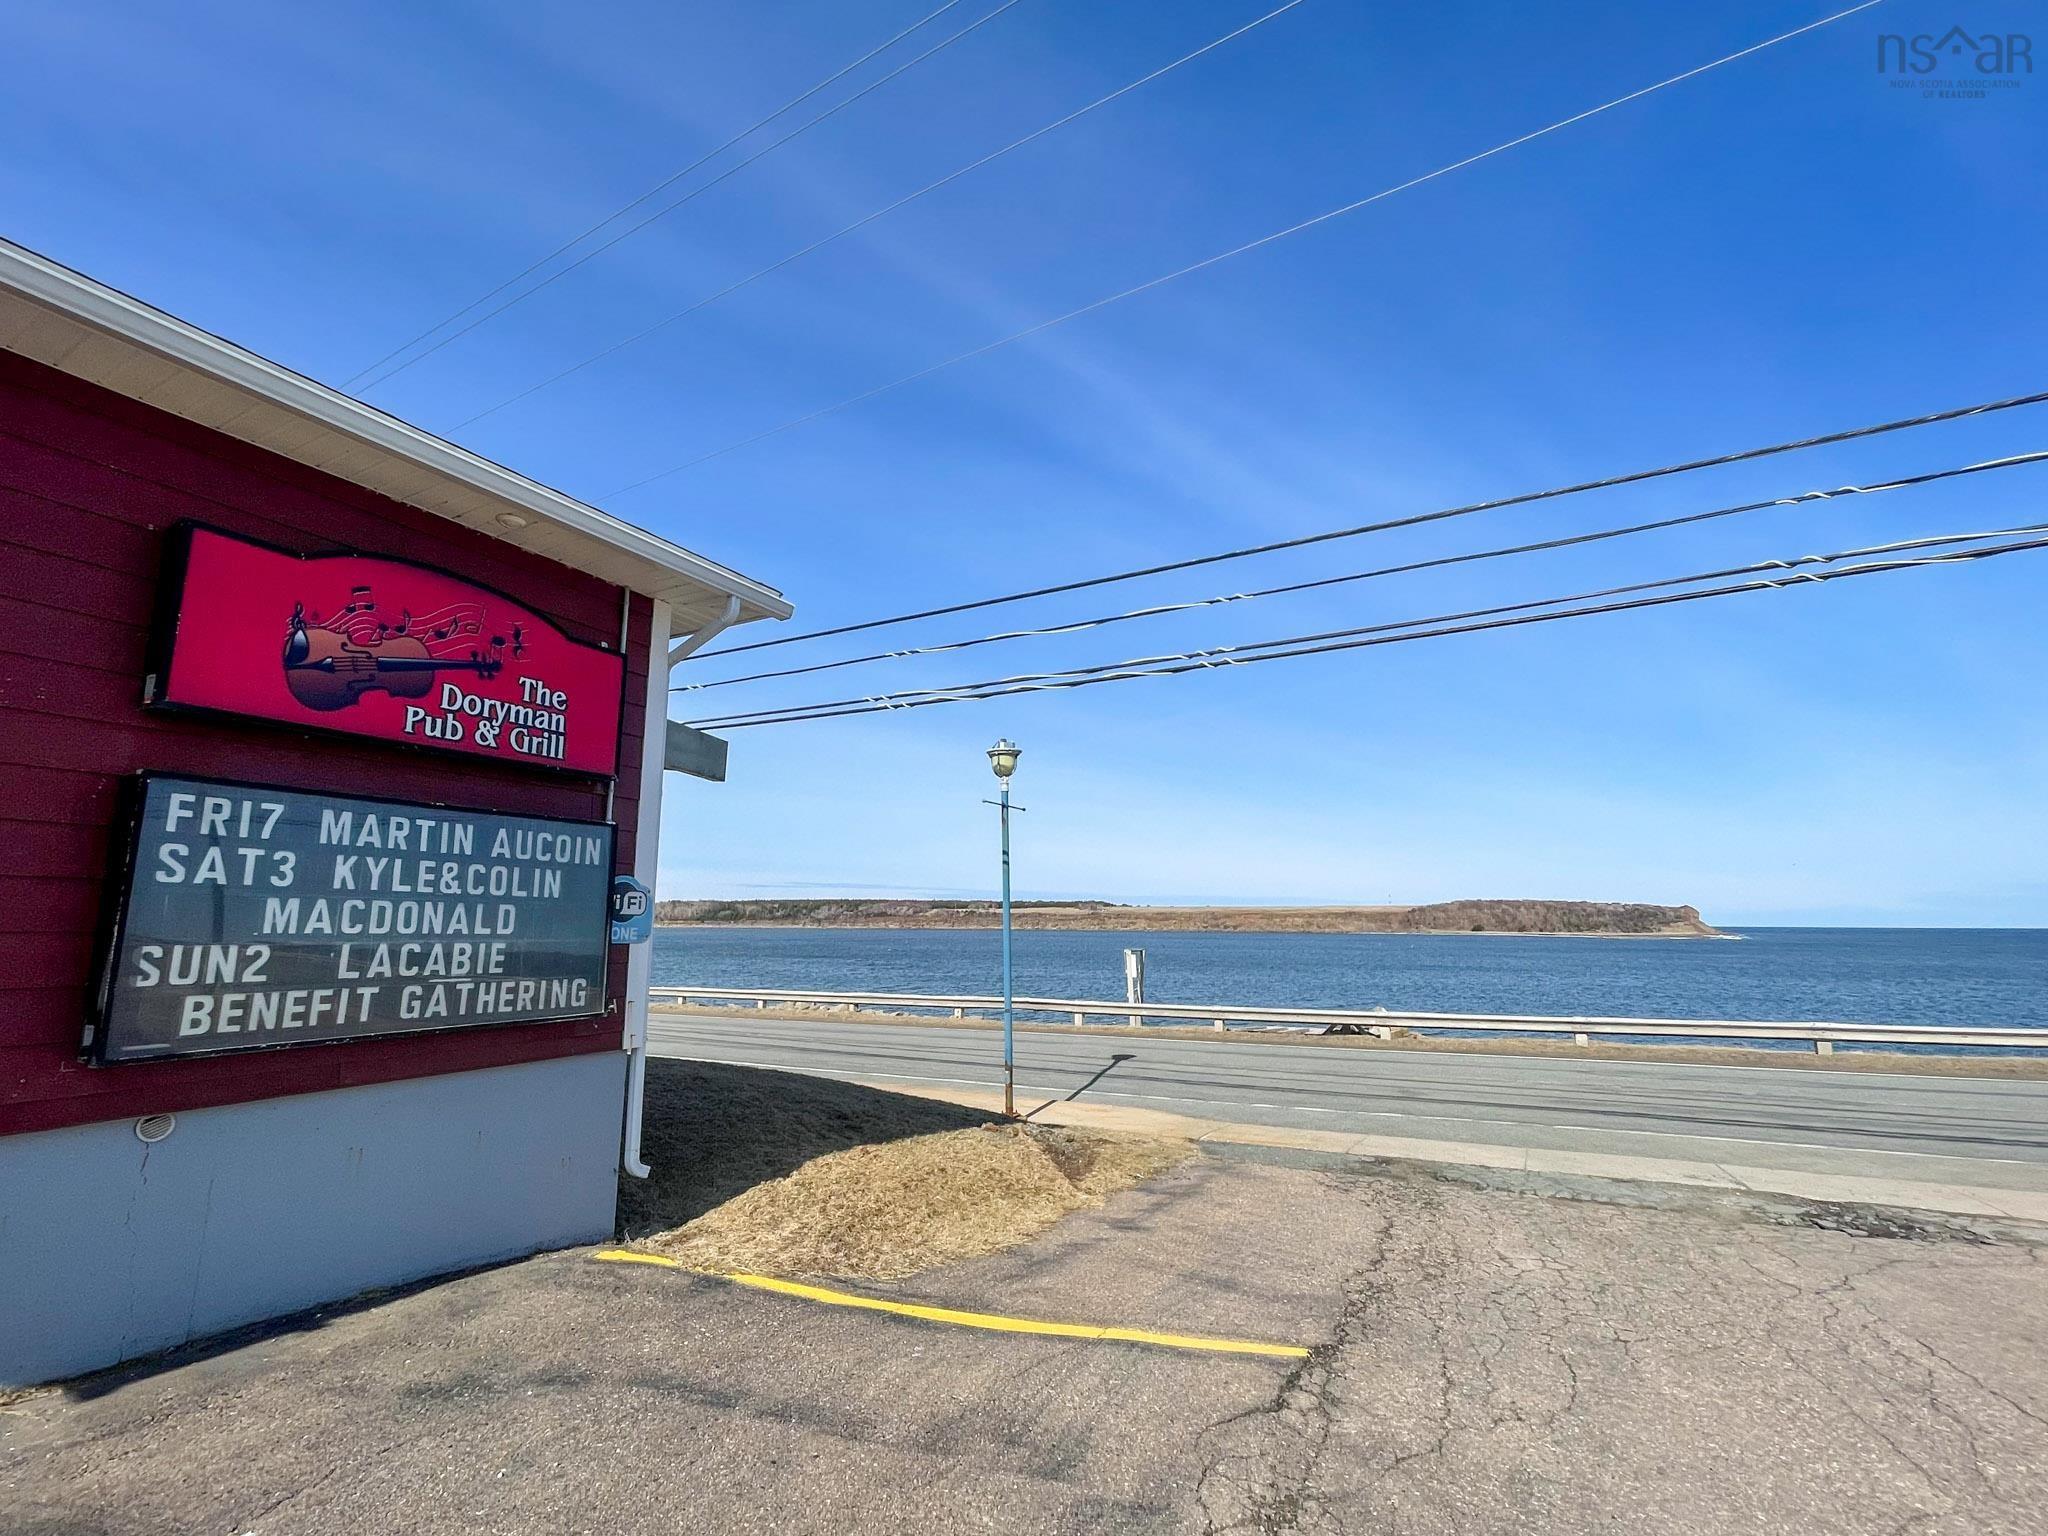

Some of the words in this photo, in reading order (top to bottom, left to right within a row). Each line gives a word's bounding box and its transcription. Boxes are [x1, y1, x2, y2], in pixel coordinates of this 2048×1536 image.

[440, 683, 566, 733] Doryman
[519, 676, 567, 710] The
[404, 706, 463, 741] Pub
[474, 720, 500, 748] &
[509, 728, 565, 760] Grill
[165, 792, 286, 840] FRI7
[319, 809, 474, 855] MARTIN
[491, 827, 601, 866] AUCOIN
[155, 843, 296, 887] SAT3
[333, 854, 562, 899] KYLE&COLIN
[262, 897, 516, 935] MACDONALD
[135, 944, 271, 988] SUN2
[337, 942, 506, 980] LACABIE
[179, 986, 380, 1037] BENEFIT
[400, 977, 588, 1019] GATHERING
